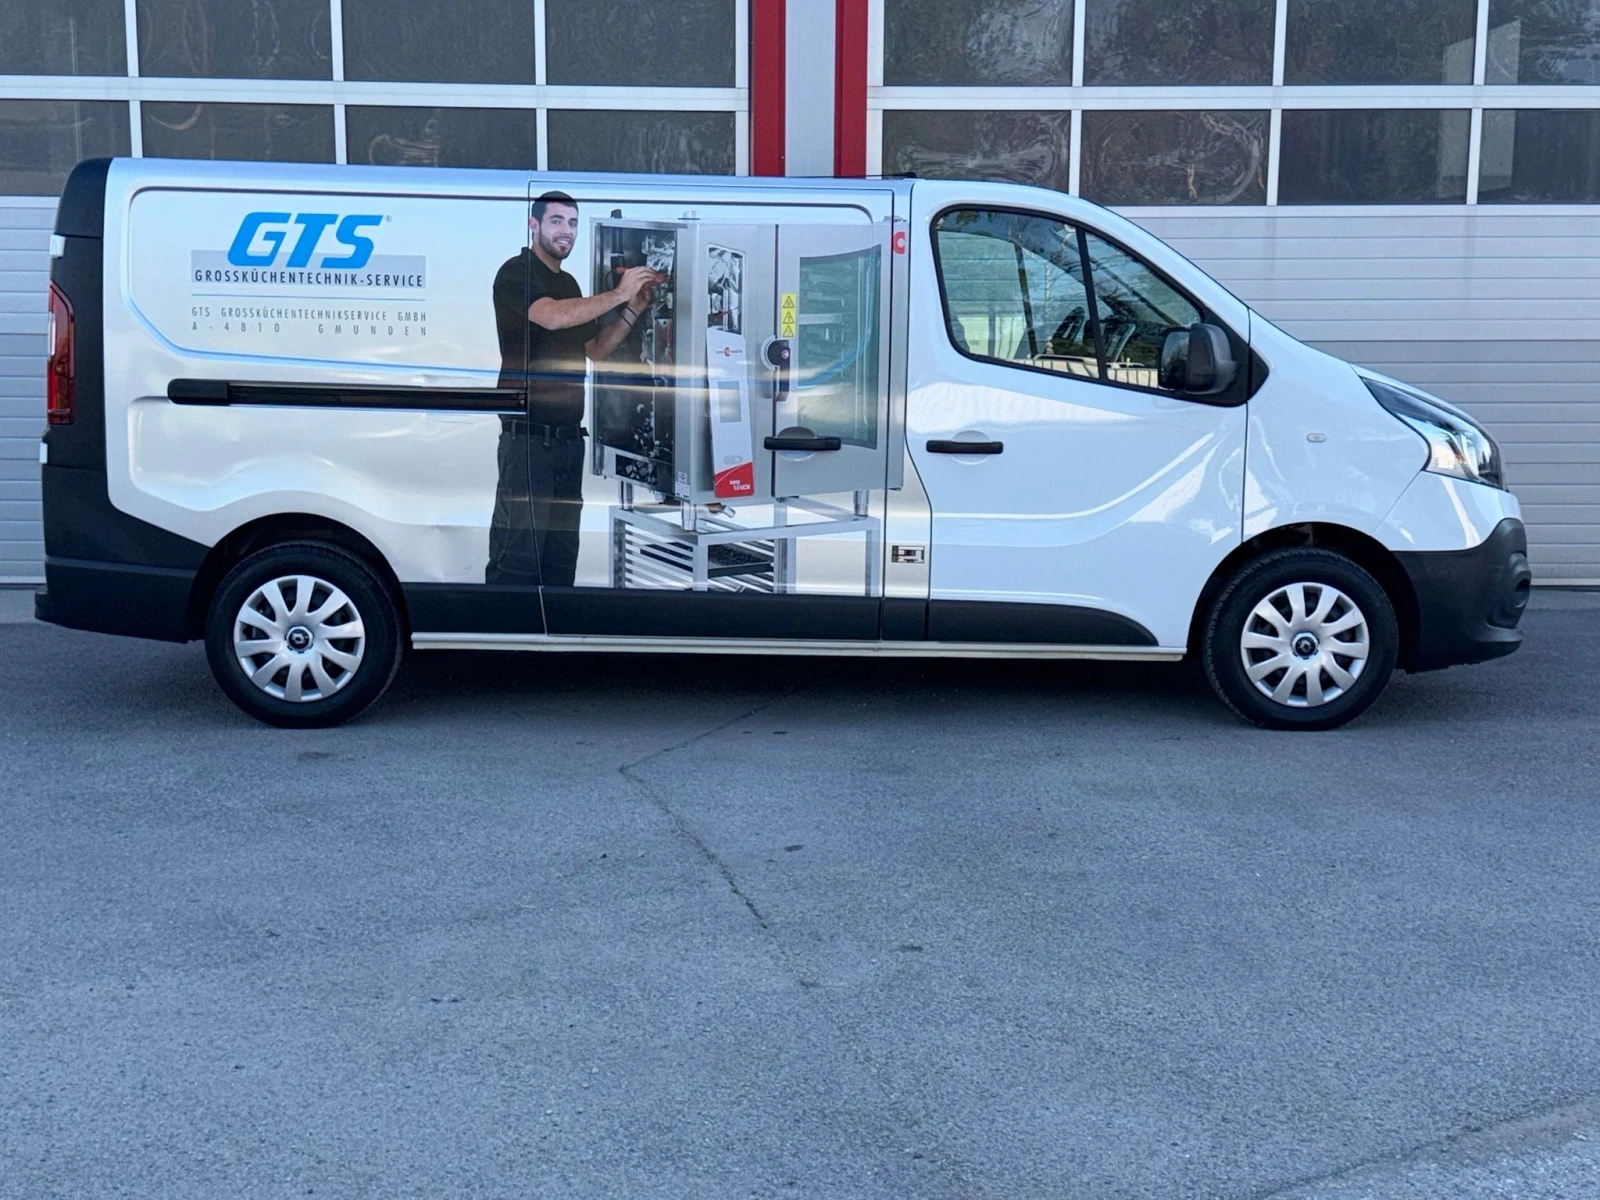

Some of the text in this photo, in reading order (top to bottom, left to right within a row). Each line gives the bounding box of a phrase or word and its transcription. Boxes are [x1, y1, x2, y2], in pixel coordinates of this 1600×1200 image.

[227, 211, 384, 269] GTS
[195, 268, 423, 287] GROSSKÜCHENTECHNIK-SERVICE
[191, 306, 427, 322] GTS GROSSKÜCHENTECHNIKSERVICE GMBH
[318, 323, 427, 336] GMUNDEN
